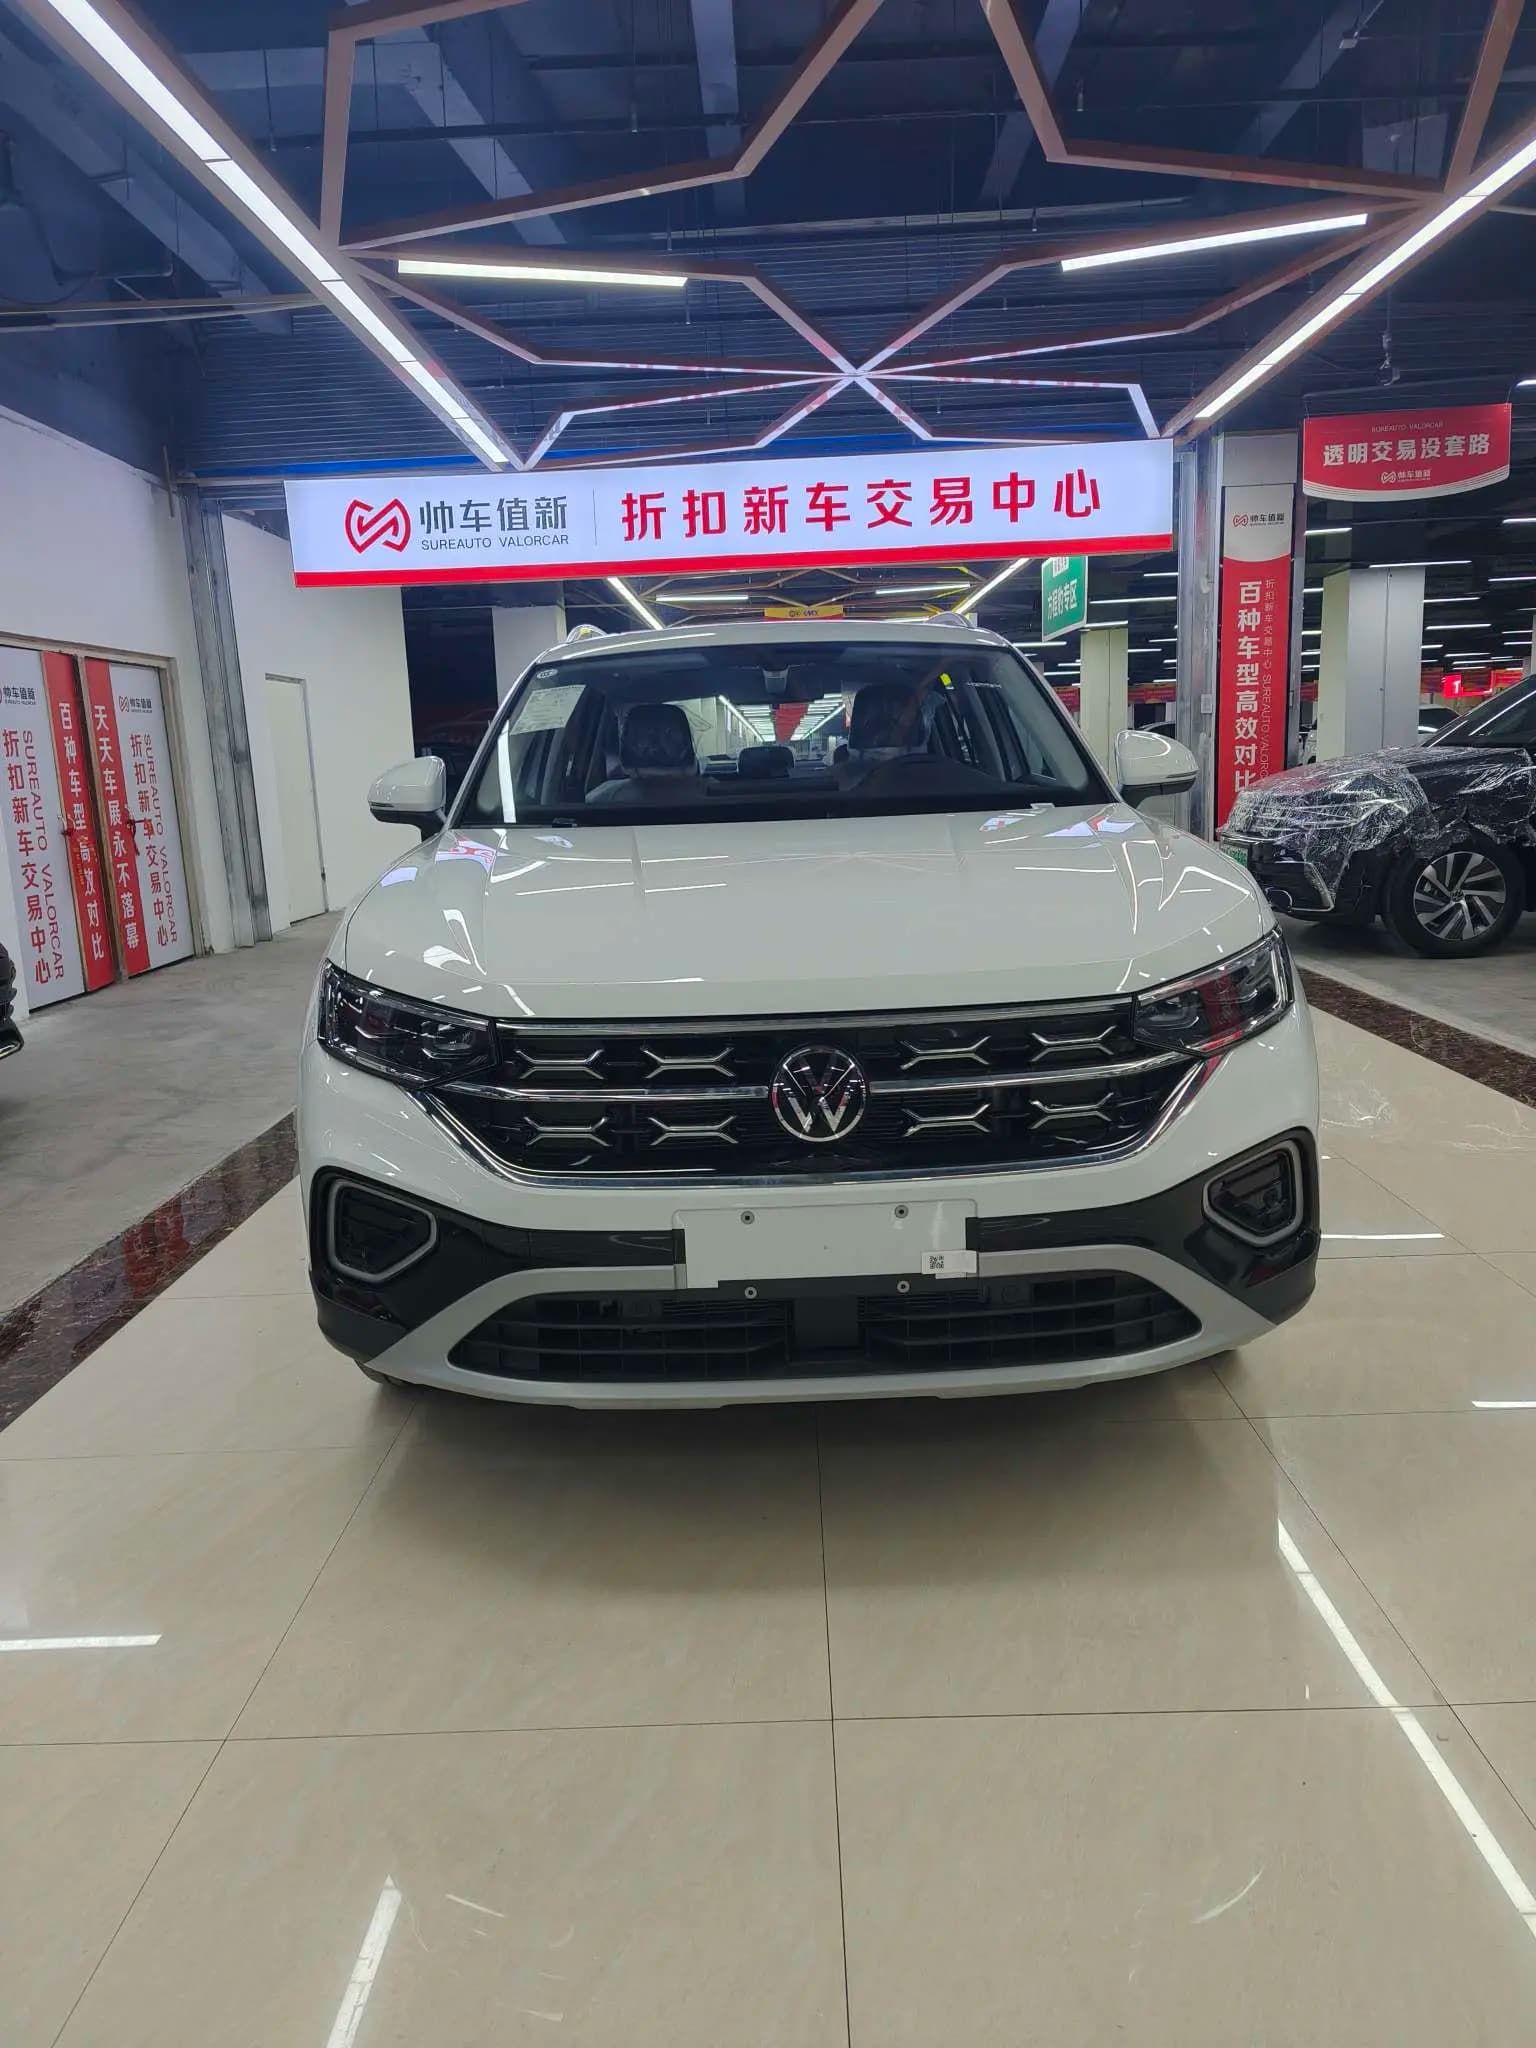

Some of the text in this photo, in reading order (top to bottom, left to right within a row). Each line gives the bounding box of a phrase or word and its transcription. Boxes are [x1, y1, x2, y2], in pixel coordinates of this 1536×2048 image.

[420, 468, 1101, 542] 帅车值新 折扣新车交易中心
[421, 534, 569, 551] SUREAUTO VALORCAR
[1323, 433, 1491, 467] 透明交易没套路
[1234, 581, 1262, 793] 百种车型高效对比
[3, 729, 51, 985] 折扣新车交易中心
[23, 731, 65, 980] SUREAUTO VALORCAR
[59, 703, 104, 960] 百种车型高效对比
[94, 705, 139, 950] 天天车展永不落幕
[130, 734, 168, 946] 折扣新车交易中心
[144, 735, 178, 943] SUREAUTO VALORCAR
